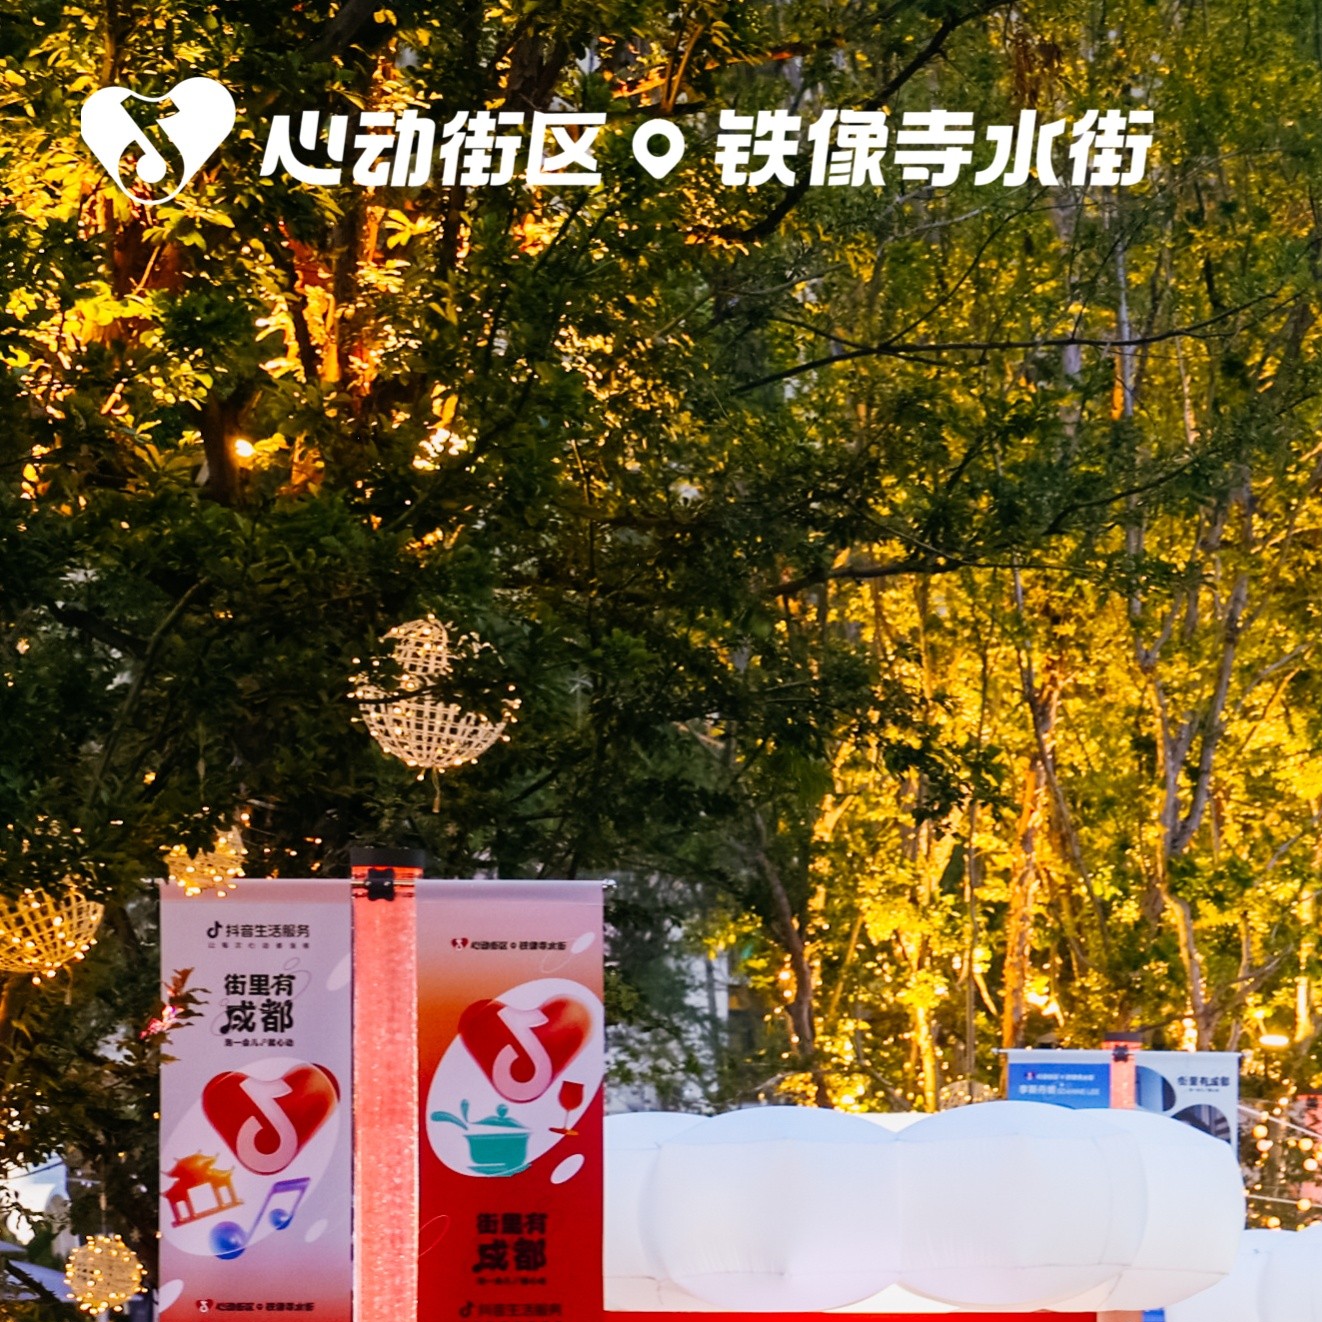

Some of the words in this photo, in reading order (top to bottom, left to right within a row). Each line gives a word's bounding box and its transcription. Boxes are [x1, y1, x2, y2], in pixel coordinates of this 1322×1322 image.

[224, 973, 296, 996] 街里有
[219, 998, 294, 1034] 成都
